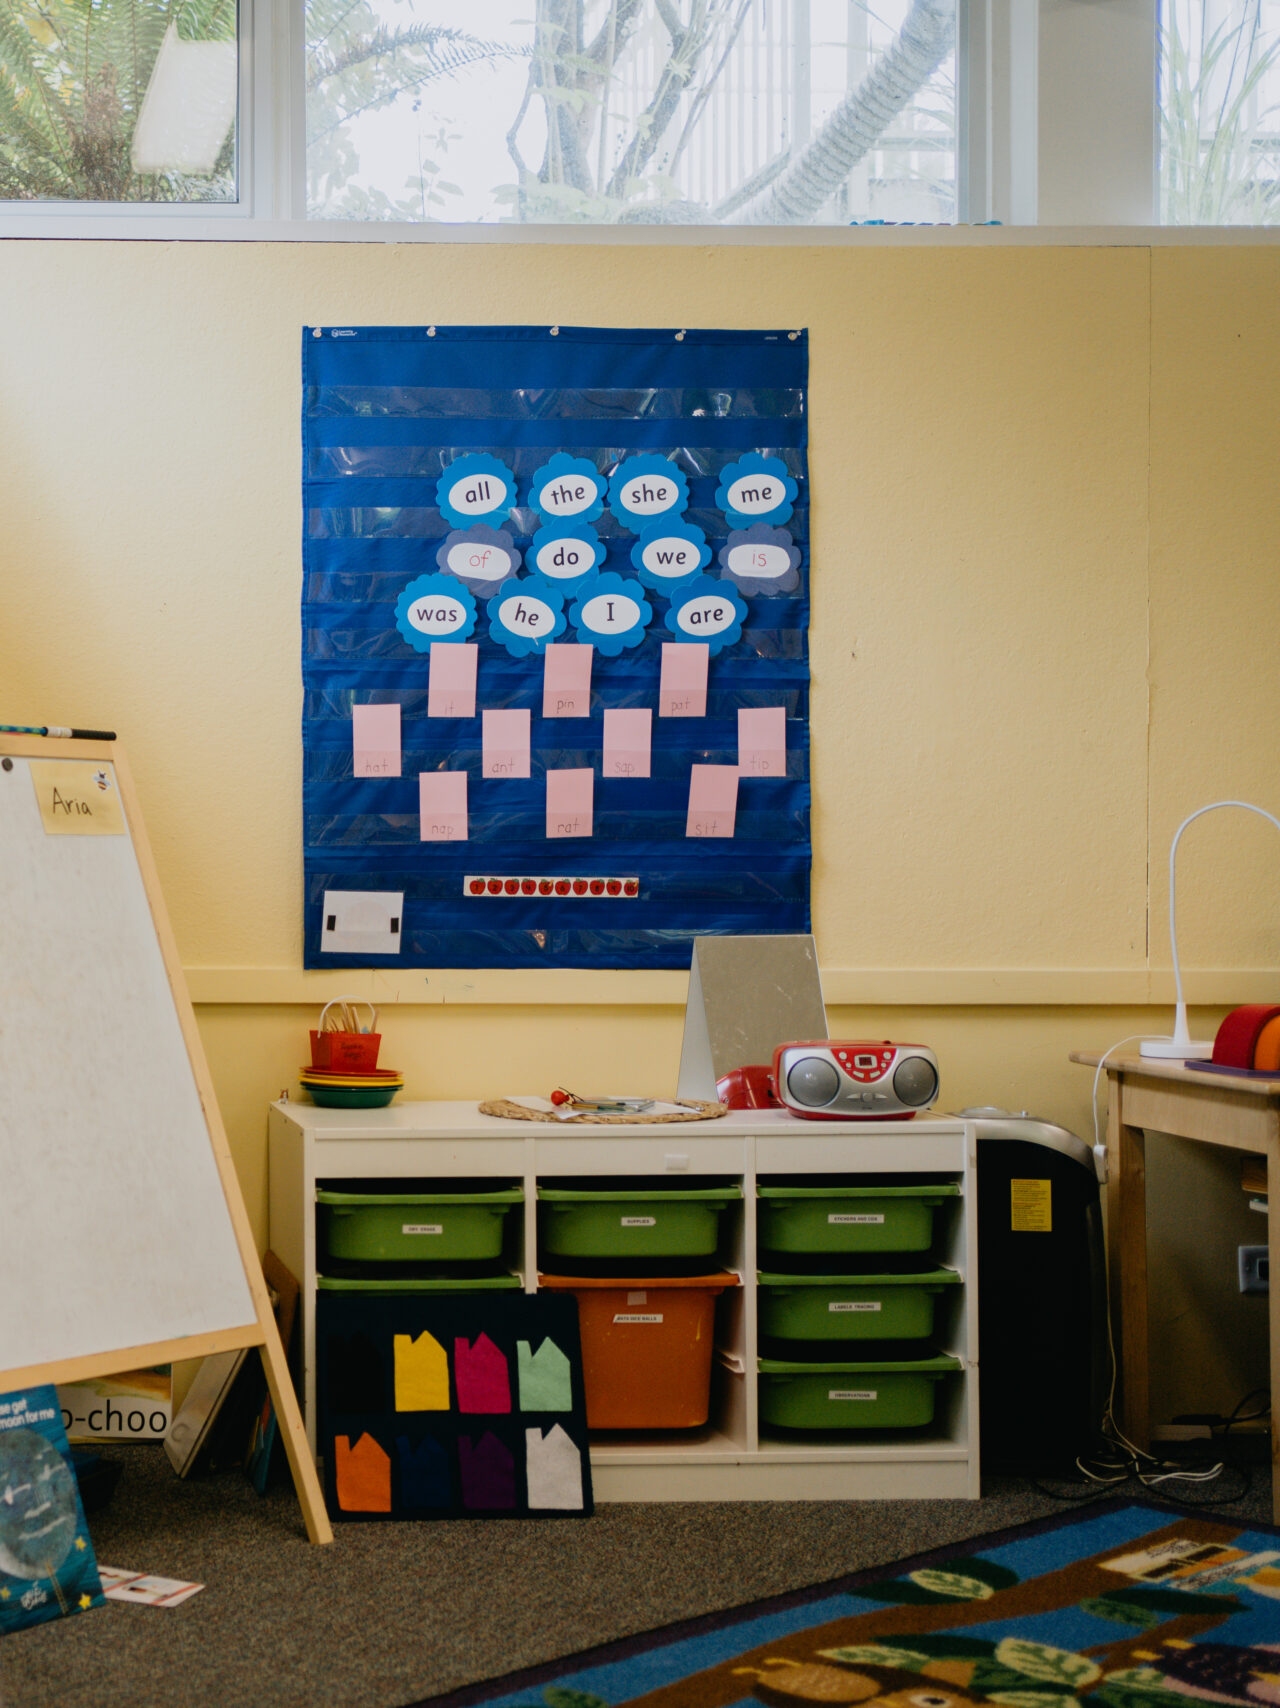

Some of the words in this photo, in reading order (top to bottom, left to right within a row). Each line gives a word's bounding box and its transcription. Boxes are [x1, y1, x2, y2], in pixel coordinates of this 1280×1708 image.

[464, 481, 491, 503] all
[550, 484, 586, 505] the
[631, 483, 667, 504] she
[741, 486, 772, 503] me
[469, 550, 492, 569] of
[552, 547, 579, 566] do
[656, 551, 687, 565] we
[751, 550, 768, 568] is
[417, 607, 458, 622] was
[514, 602, 539, 626] he
[606, 602, 615, 622] I
[689, 607, 724, 625] are
[556, 699, 575, 714] pin
[671, 697, 691, 714] pat
[365, 757, 389, 773] hat
[491, 757, 516, 774] ant
[52, 786, 93, 817] Aria
[431, 823, 455, 840] nap
[556, 818, 581, 834] rat
[695, 821, 719, 837] sit
[11, 1397, 27, 1416] get
[25, 1410, 39, 1424] for
[39, 1407, 56, 1421] me
